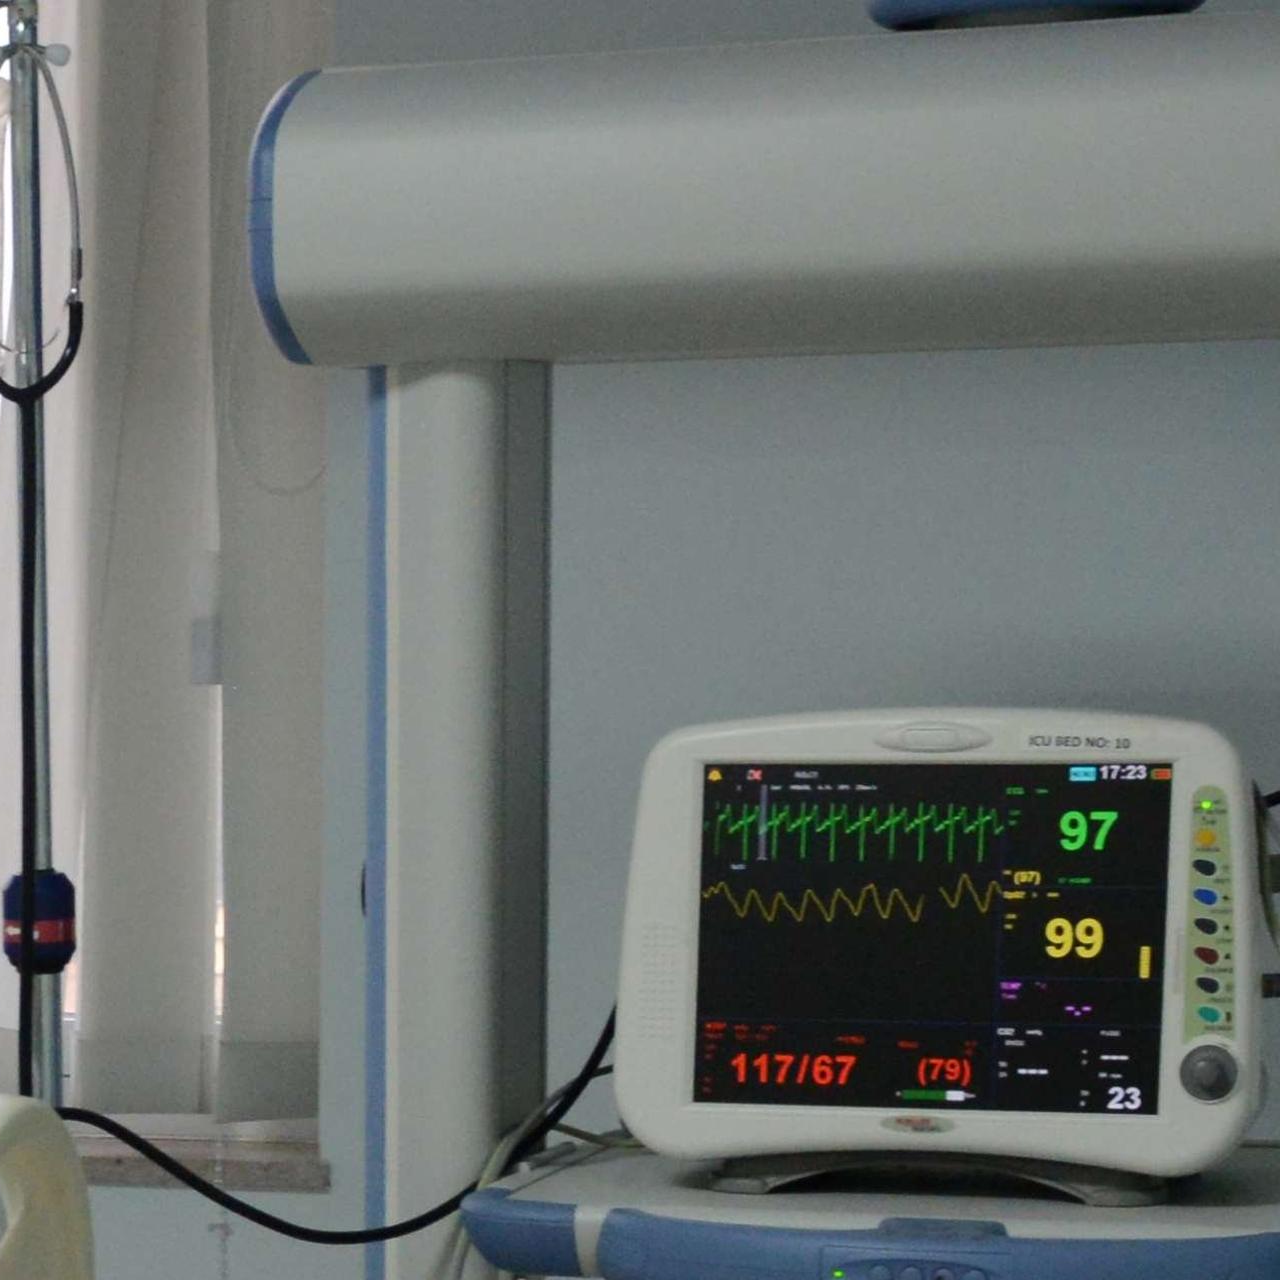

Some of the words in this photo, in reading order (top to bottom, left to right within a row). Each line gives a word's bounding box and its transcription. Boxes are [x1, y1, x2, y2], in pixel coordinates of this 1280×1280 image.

[1055, 736, 1082, 747] BED
[1115, 738, 1131, 749] 10
[1099, 765, 1147, 780] 17:23
[1059, 810, 1119, 850] 97
[1045, 917, 1104, 958] 99
[731, 1053, 856, 1085] 117/67
[917, 1058, 971, 1087] (79)
[1106, 1086, 1142, 1110] 23
